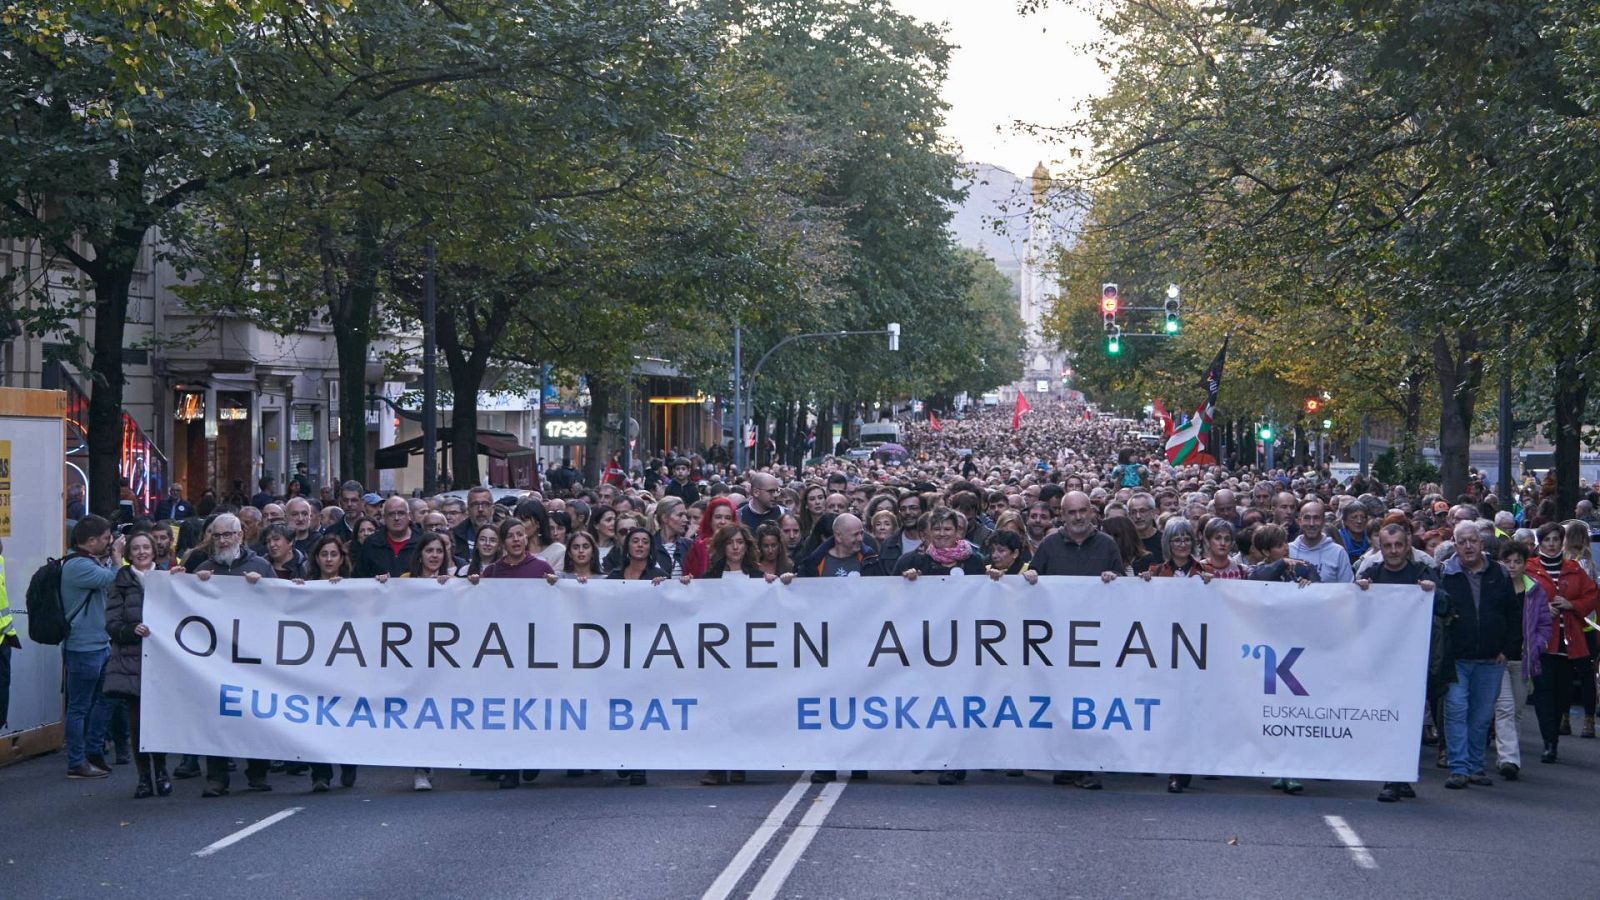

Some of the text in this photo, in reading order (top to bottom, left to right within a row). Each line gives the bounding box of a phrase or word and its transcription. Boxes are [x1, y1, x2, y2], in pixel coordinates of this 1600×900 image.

[545, 420, 587, 438] 17:32
[174, 615, 1208, 671] OLDARRALDIAREN AURREAN
[219, 684, 1161, 731] EUSKARAREKIN BAT EUSKARAZ BAT
[1263, 705, 1399, 721] EUSKALGINTZAREN
[1262, 725, 1353, 739] KONTSEILUA
